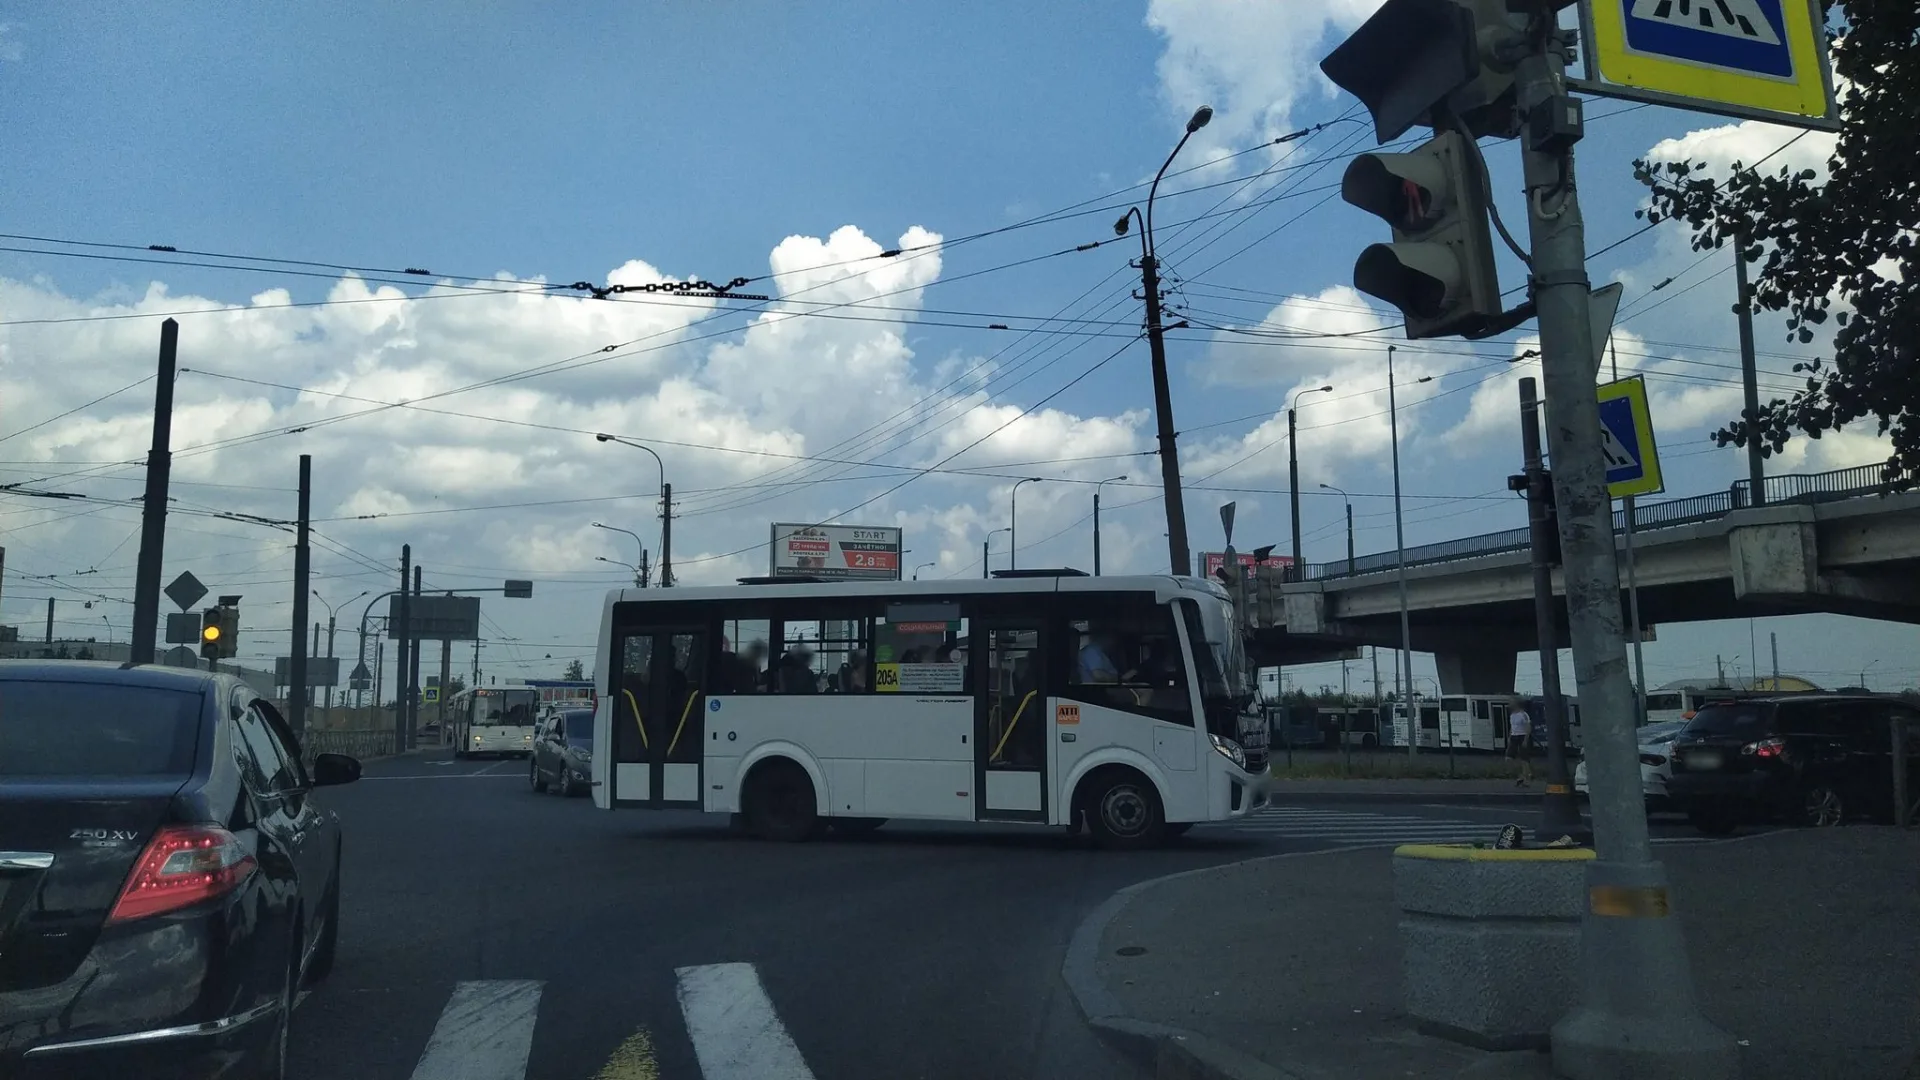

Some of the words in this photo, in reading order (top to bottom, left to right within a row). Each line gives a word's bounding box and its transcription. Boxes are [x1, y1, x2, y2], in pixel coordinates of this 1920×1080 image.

[853, 531, 886, 539] START
[853, 543, 887, 551] ЗАЧЁТНО!
[855, 554, 875, 567] 2,8
[112, 830, 138, 840] XV
